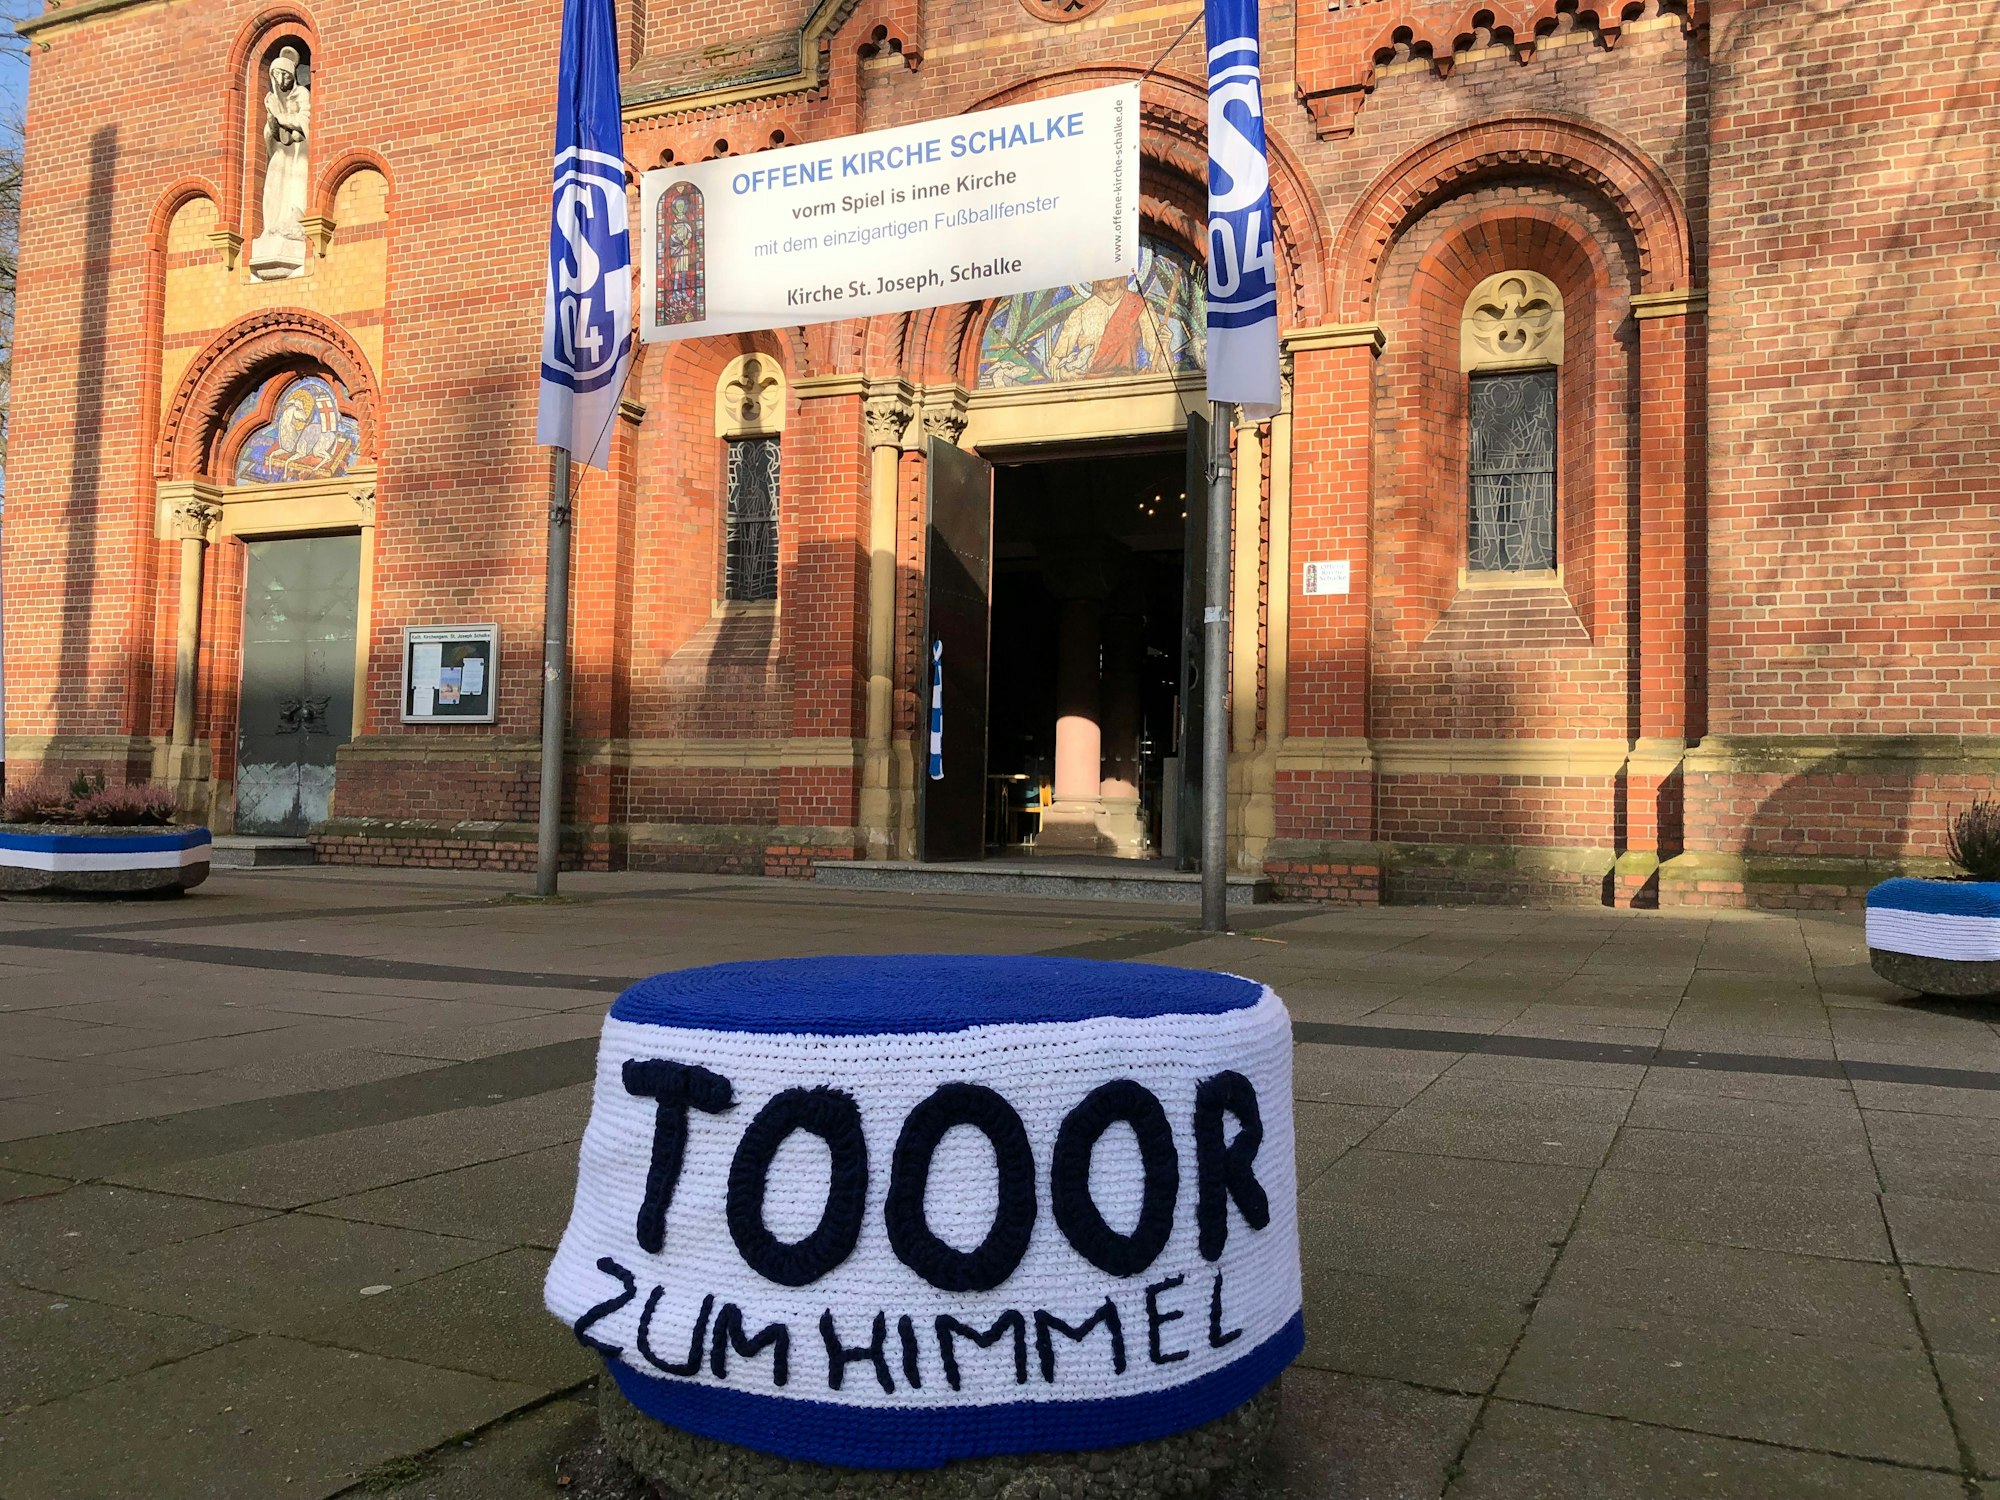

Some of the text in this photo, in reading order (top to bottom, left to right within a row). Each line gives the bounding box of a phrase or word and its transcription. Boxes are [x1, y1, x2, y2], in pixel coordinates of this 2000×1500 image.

[732, 112, 1084, 195] OFFENE KIRCHE SCHALKE
[792, 170, 1017, 220] vorm Spiel is inne Kirche
[1112, 98, 1123, 263] www.offene-kirche-schalke.de
[754, 195, 1060, 257] mit dem einzigartigen Fußballfenster
[787, 257, 1022, 306] Kirche St. Joseph, Schalke
[622, 1058, 1269, 1292] TOOOR
[574, 1257, 1242, 1394] ZUM HIMMEL
